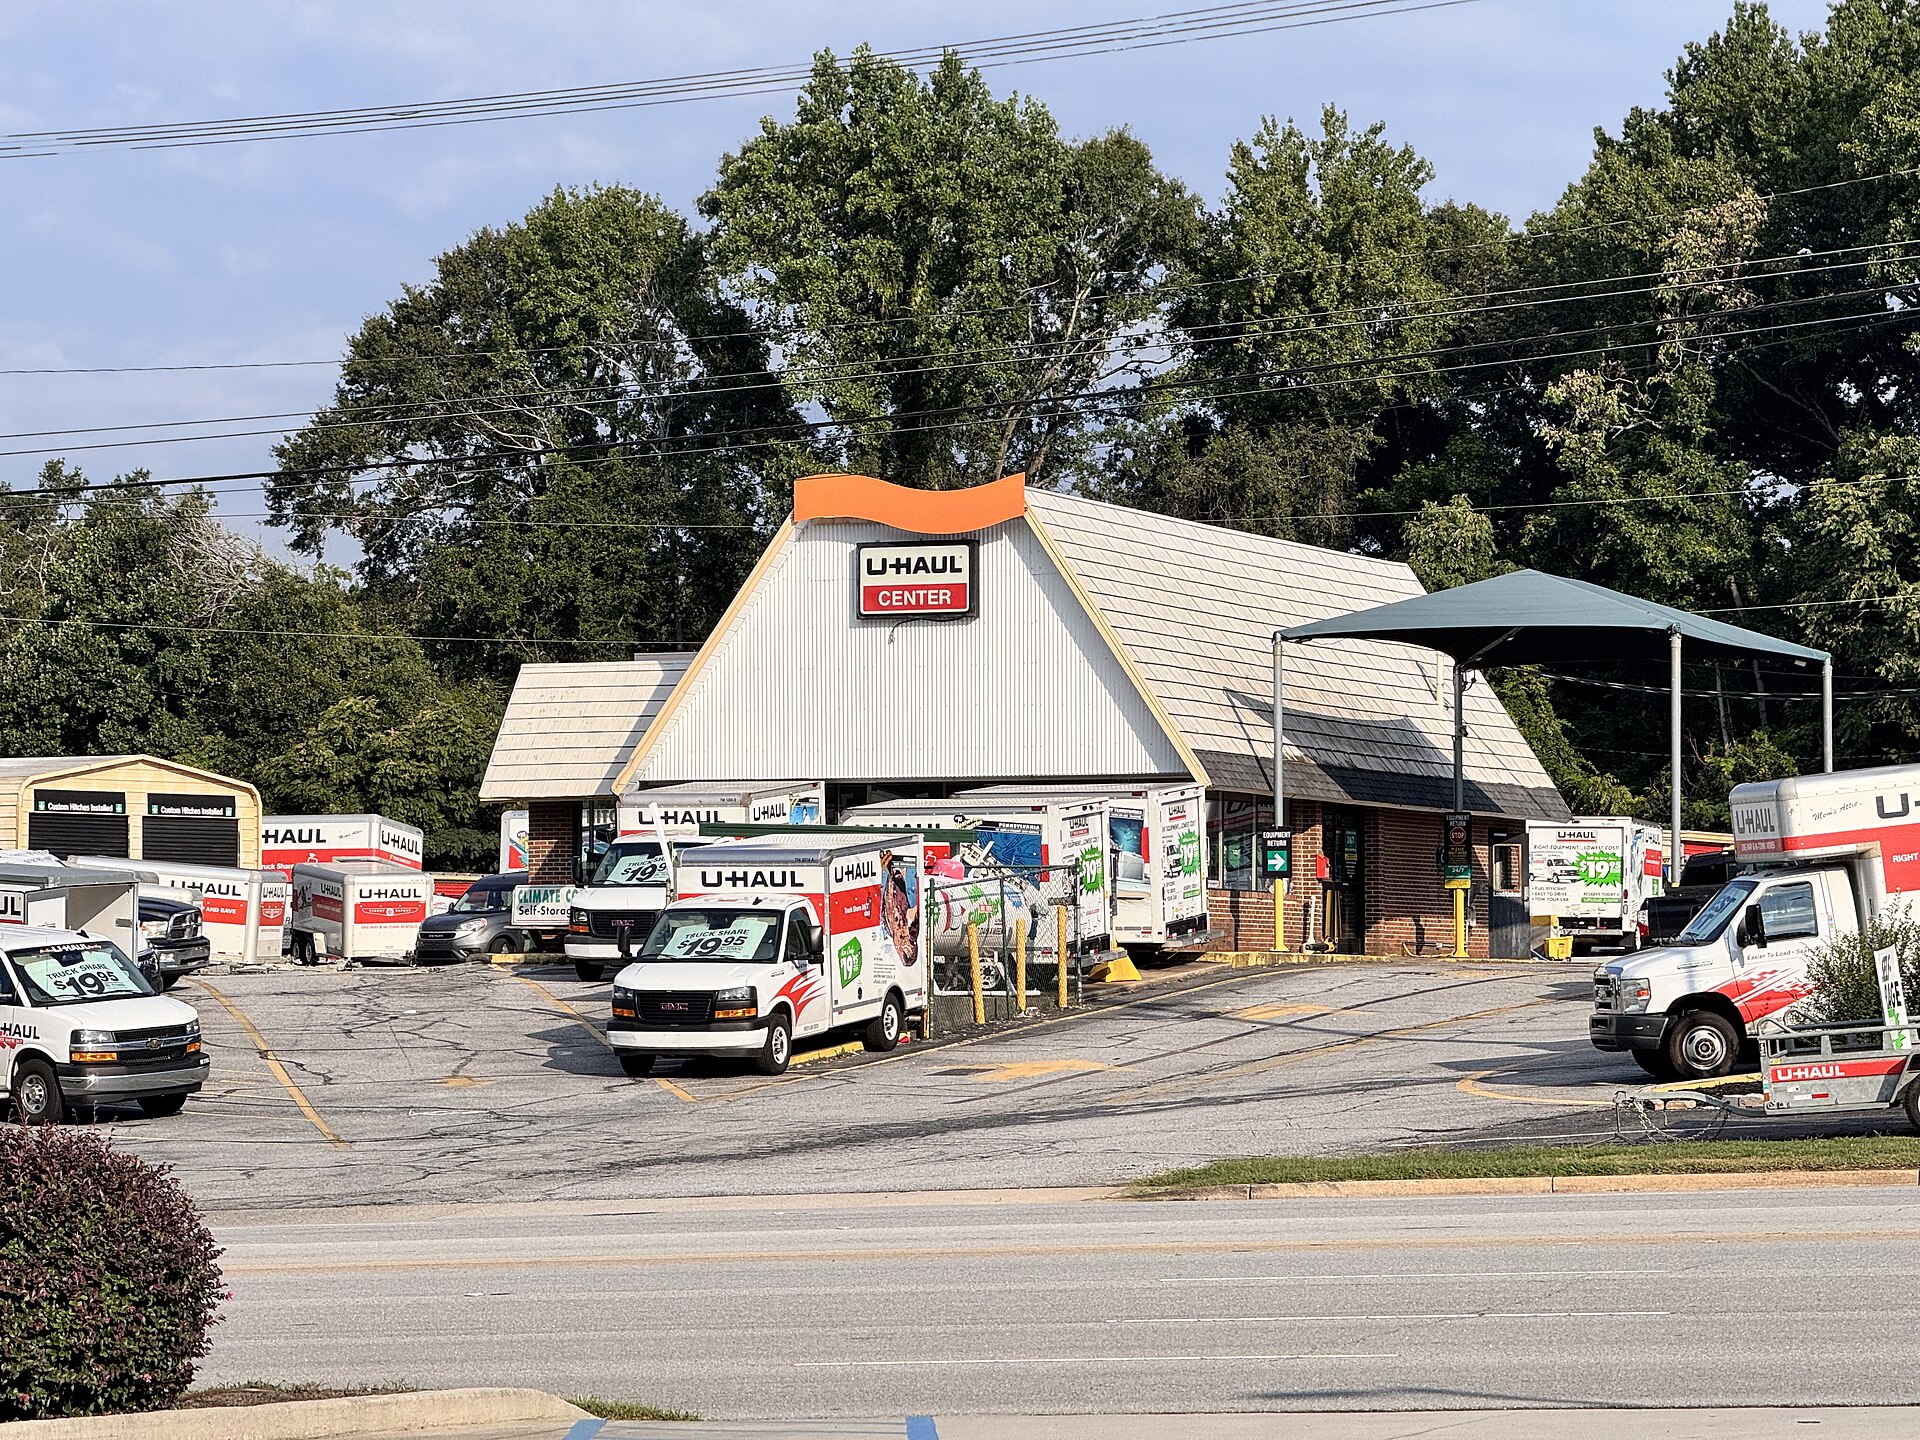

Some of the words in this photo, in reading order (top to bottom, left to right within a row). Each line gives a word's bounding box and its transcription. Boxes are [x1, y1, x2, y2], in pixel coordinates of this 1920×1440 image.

[866, 555, 963, 576] U-HAUL
[878, 589, 952, 607] CENTER
[47, 802, 70, 811] Custom
[70, 803, 90, 811] Hitches
[90, 804, 114, 812] Installed
[160, 805, 182, 814] Custom
[181, 806, 201, 815] Hitches
[201, 807, 224, 816] Installed
[753, 803, 787, 821] U-HAUL
[998, 822, 1040, 831] PENNSYLVANIA
[1735, 807, 1776, 835] U-HAUL
[261, 828, 327, 844] -HAUL
[1262, 831, 1291, 839] EQUIPMENT
[1557, 831, 1596, 839] U-HAUL
[381, 830, 420, 855] U-HAUL
[1266, 839, 1287, 847] RETURN
[1892, 853, 1919, 864] RIGHT
[834, 860, 877, 883] U-HAUL
[701, 870, 805, 888] U-HAUL
[262, 886, 285, 898] U-HAUL
[359, 888, 422, 899] U-HAUL
[517, 888, 561, 903] CLIMATE
[220, 907, 237, 915] SAVE
[518, 904, 571, 918] Self-Storag
[611, 919, 635, 927] GMC
[685, 930, 717, 939] TRUCK
[717, 928, 751, 936] SHARE
[1747, 953, 1766, 961] Easier
[1775, 949, 1791, 957] Load
[46, 967, 79, 980] TRUCK
[79, 963, 110, 972] SHARE
[660, 1002, 689, 1011] GMC
[0, 1022, 41, 1040] -HAUL
[1776, 1065, 1846, 1081] U-HAUL
